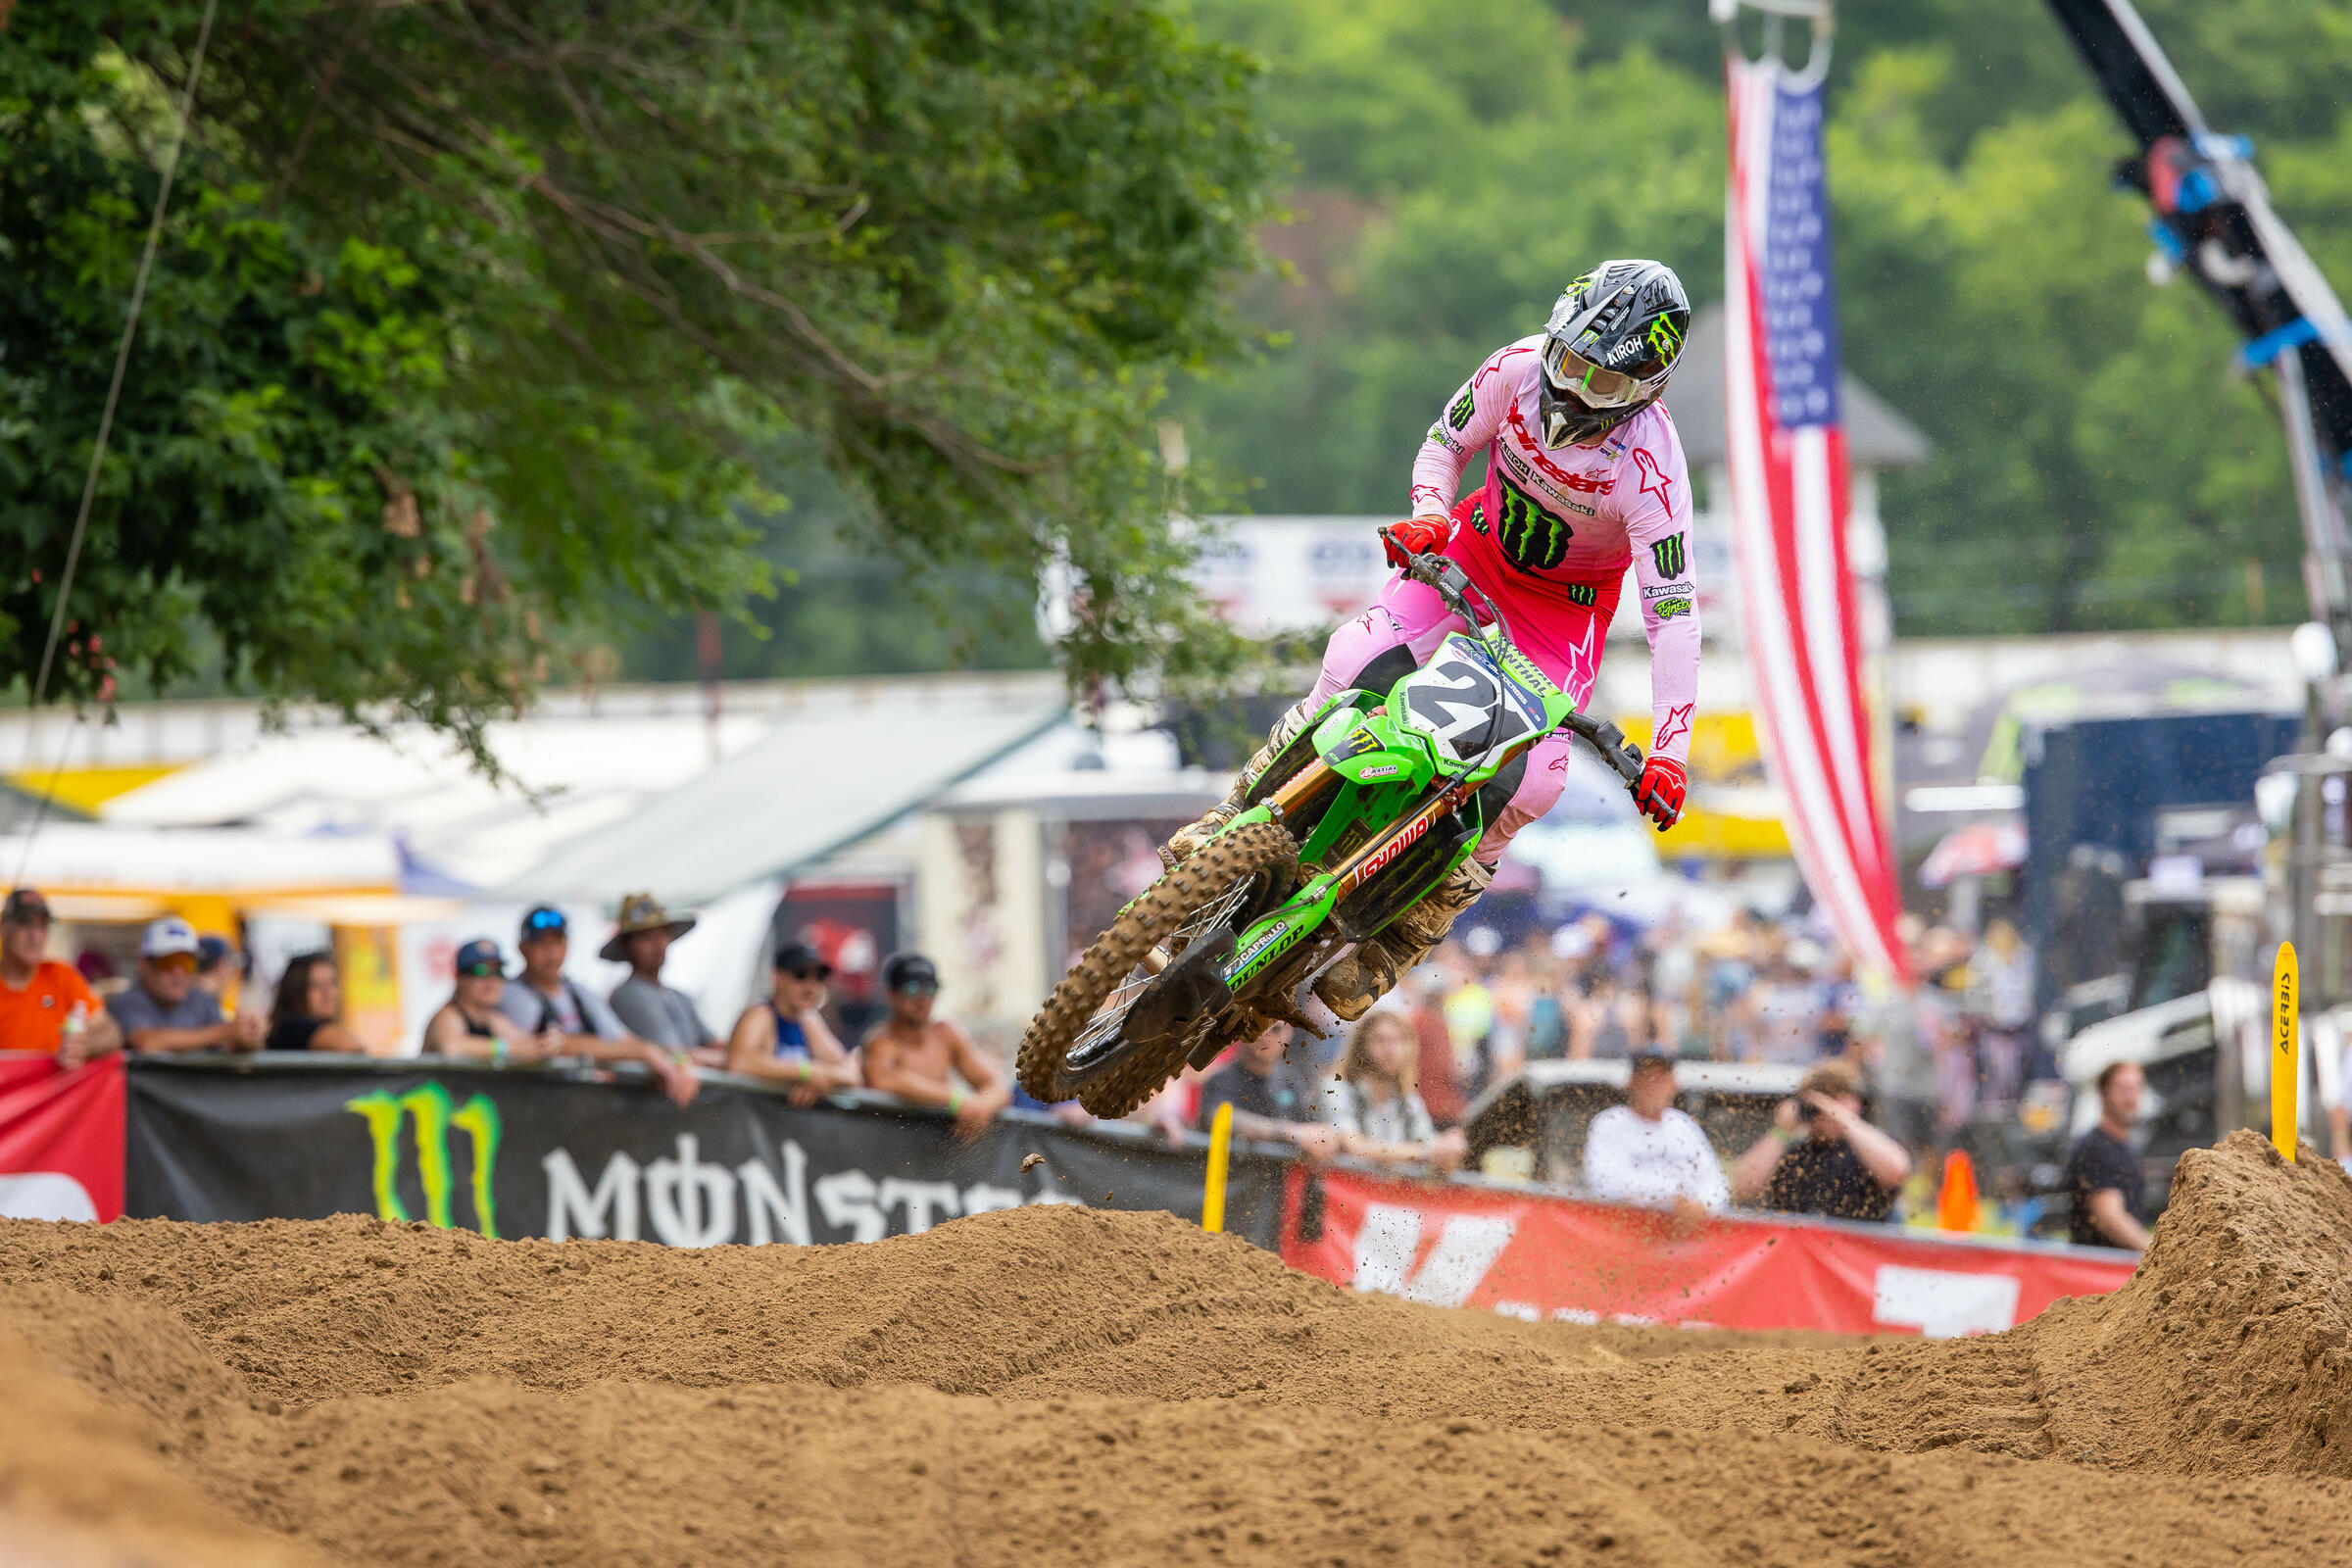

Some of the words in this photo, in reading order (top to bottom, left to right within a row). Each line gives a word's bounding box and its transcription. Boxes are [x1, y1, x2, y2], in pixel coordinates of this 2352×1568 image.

[1606, 335, 1643, 366] AIROH
[1500, 441, 1528, 473] AIROH
[1531, 471, 1593, 515] Kawasaki
[1398, 692, 1409, 724] Kawasaki
[1473, 653, 1528, 705] PROMOCROSS
[1407, 661, 1530, 761] 21
[1363, 815, 1428, 879] SHOWA
[1230, 924, 1304, 991] DUNLOP
[2279, 972, 2290, 1055] ACERBIS
[542, 1132, 1082, 1249] MONST
